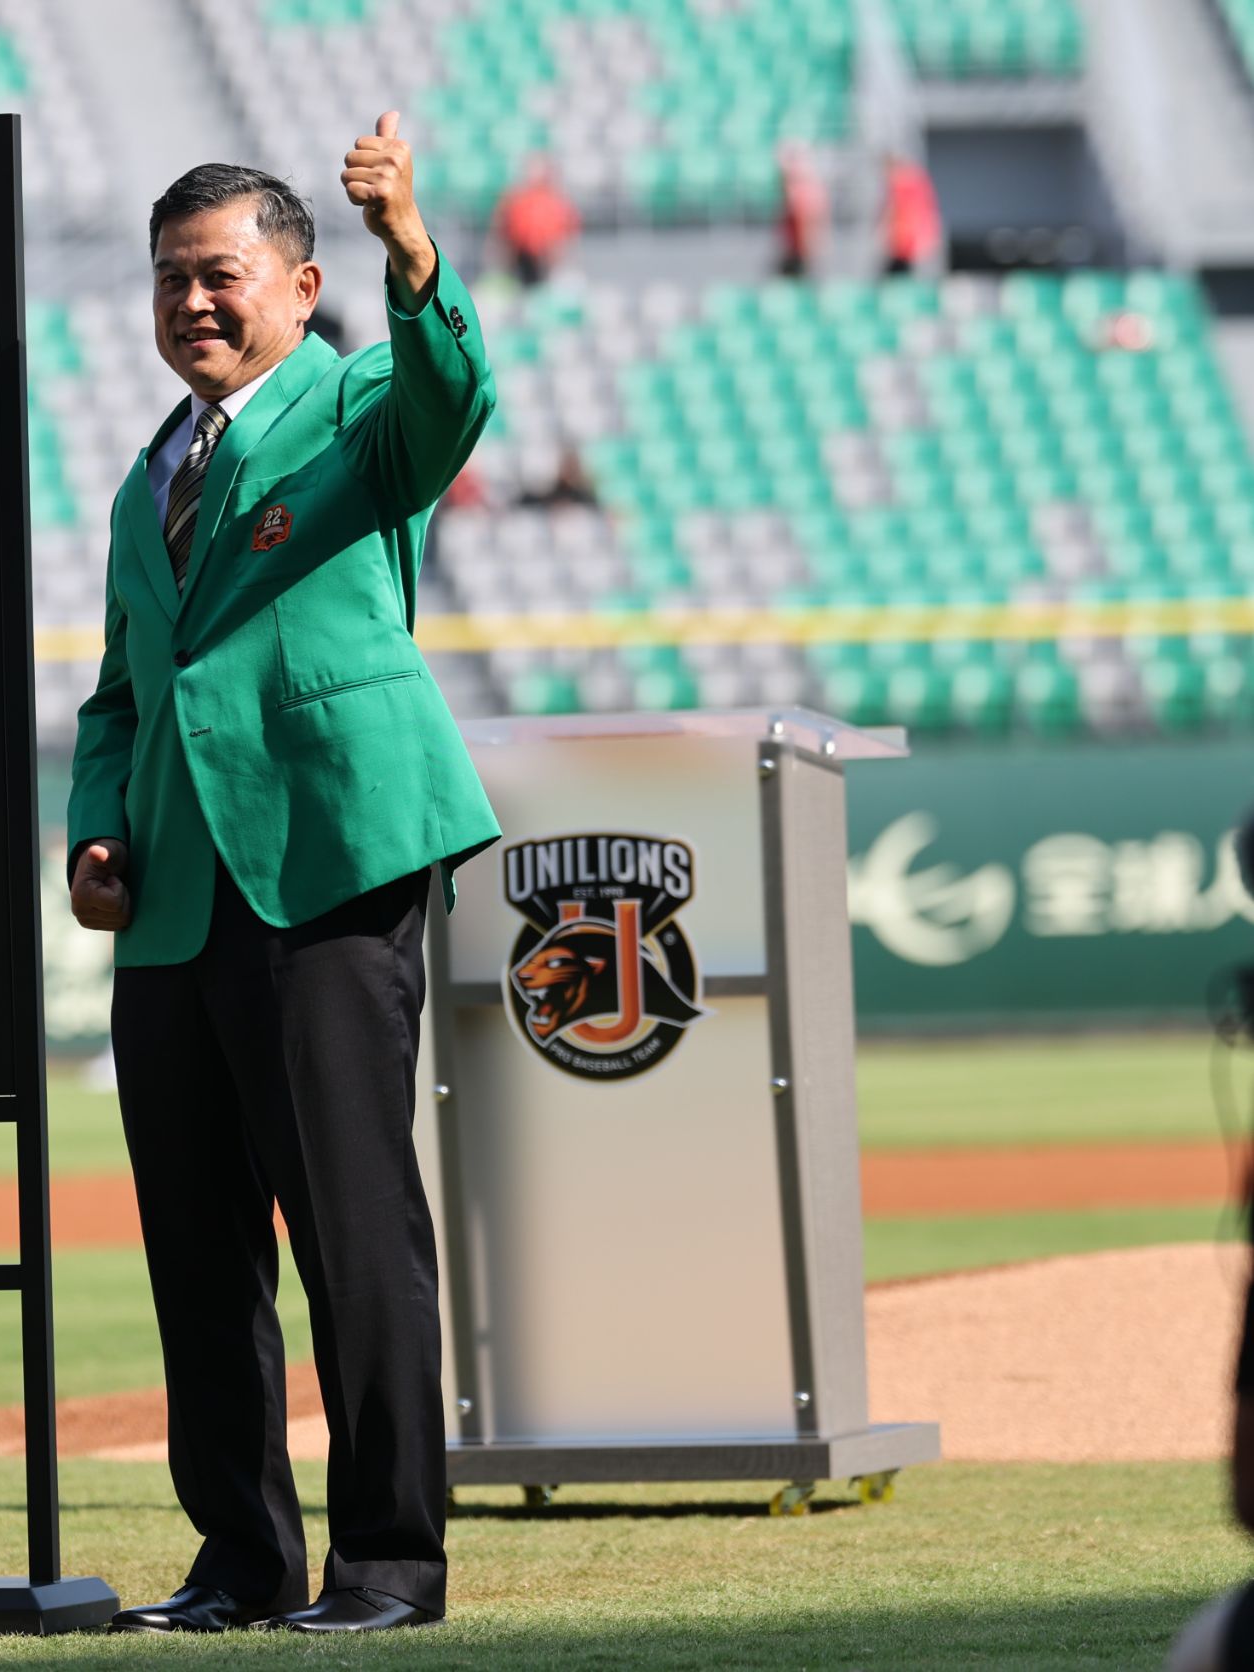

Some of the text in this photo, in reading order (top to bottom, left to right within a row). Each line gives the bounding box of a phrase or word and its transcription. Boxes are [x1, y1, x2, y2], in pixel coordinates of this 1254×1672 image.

[264, 508, 282, 529] 22
[507, 837, 690, 902] UNILIONS
[572, 1056, 633, 1072] BASEBALL
[631, 1037, 661, 1062] TEAM
